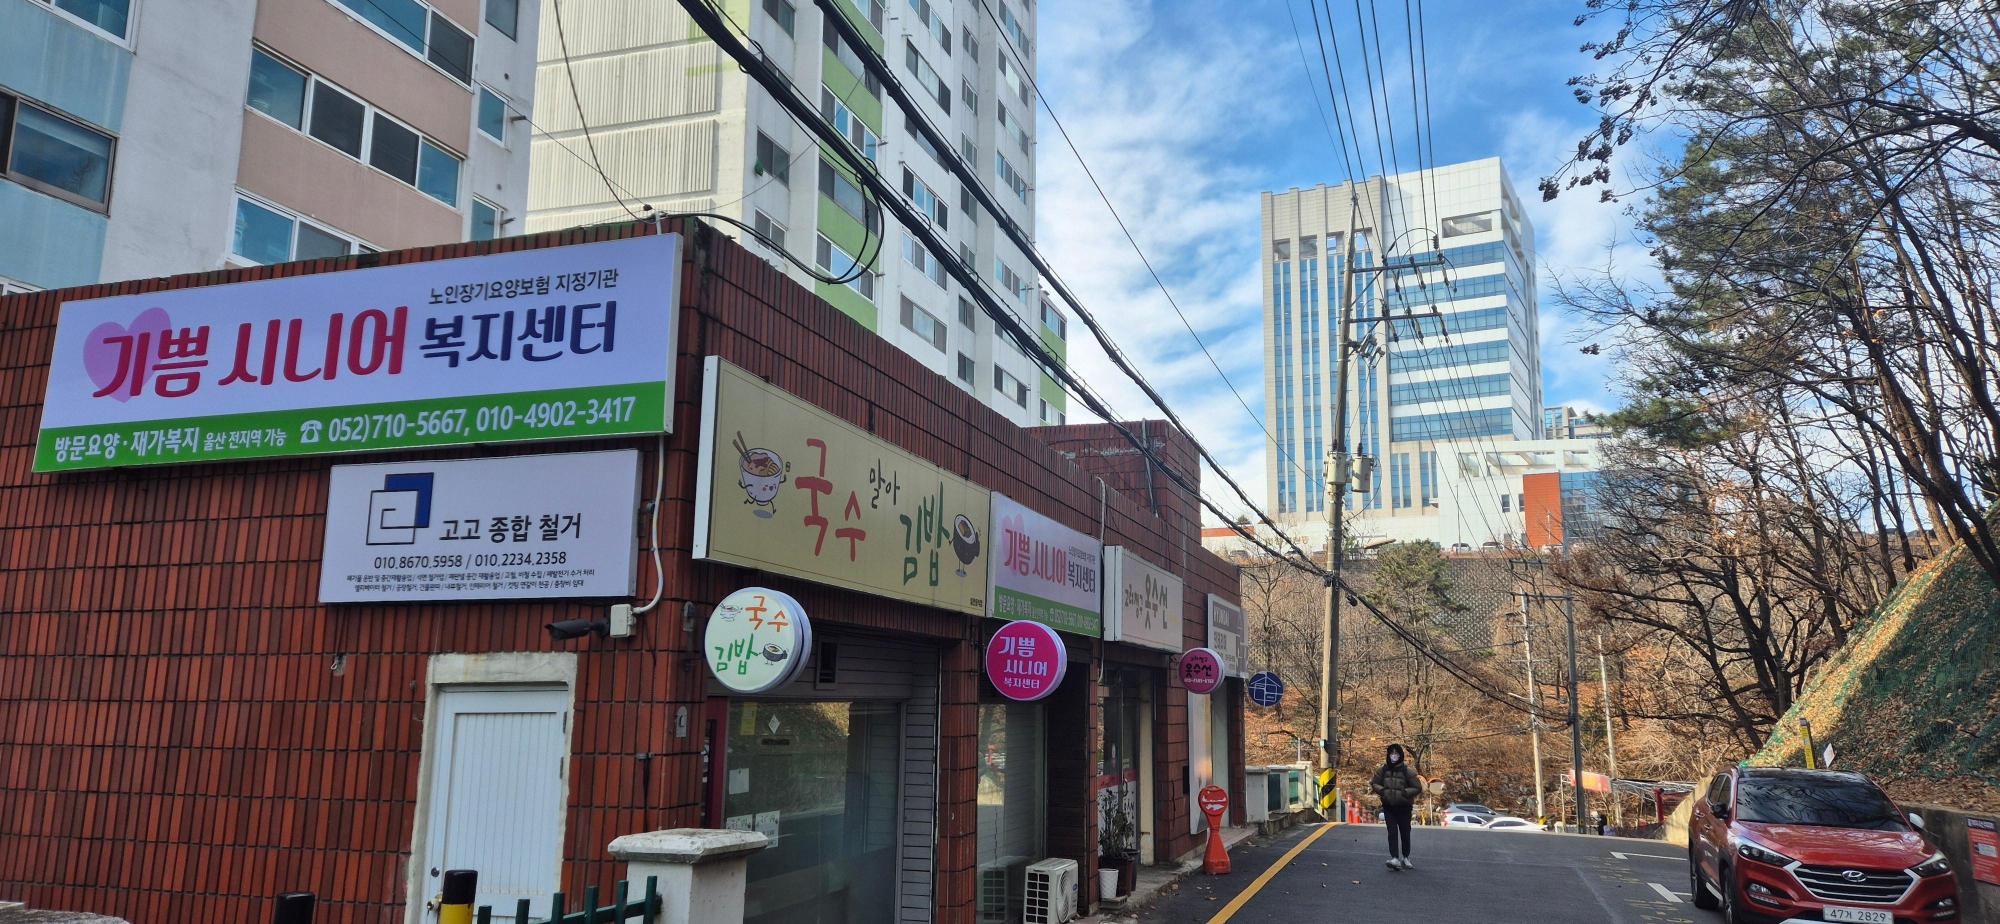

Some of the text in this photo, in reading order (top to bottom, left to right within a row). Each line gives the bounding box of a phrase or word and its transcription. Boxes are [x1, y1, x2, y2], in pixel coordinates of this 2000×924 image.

[428, 267, 619, 306] 노인장기요양보험 지정기관
[92, 301, 616, 399] 기쁨 시니어 복지센터
[131, 427, 200, 457] 재가복지
[204, 432, 226, 452] 울산
[229, 429, 262, 450] 전지역
[264, 428, 288, 447] 가능
[328, 407, 470, 444] 052)710-5667,
[475, 396, 636, 433] 010-4902-3417
[439, 512, 582, 544] 고고 종합 철거
[795, 437, 951, 587] 국수 말아 김밥
[374, 555, 463, 570] 010.8670.5958
[475, 551, 567, 567] 010.2234.2358
[1004, 528, 1031, 577] 기쁨
[1032, 540, 1067, 586] 시니어
[1068, 560, 1096, 594] 복지센터
[744, 595, 789, 633] 국수
[714, 632, 758, 676] 김밥
[998, 635, 1037, 658] 기쁨
[1003, 676, 1041, 690] 복지센터
[1004, 659, 1048, 678] 시니어
[1185, 663, 1212, 678] 옷수선
[1857, 910, 1887, 922] 2829
